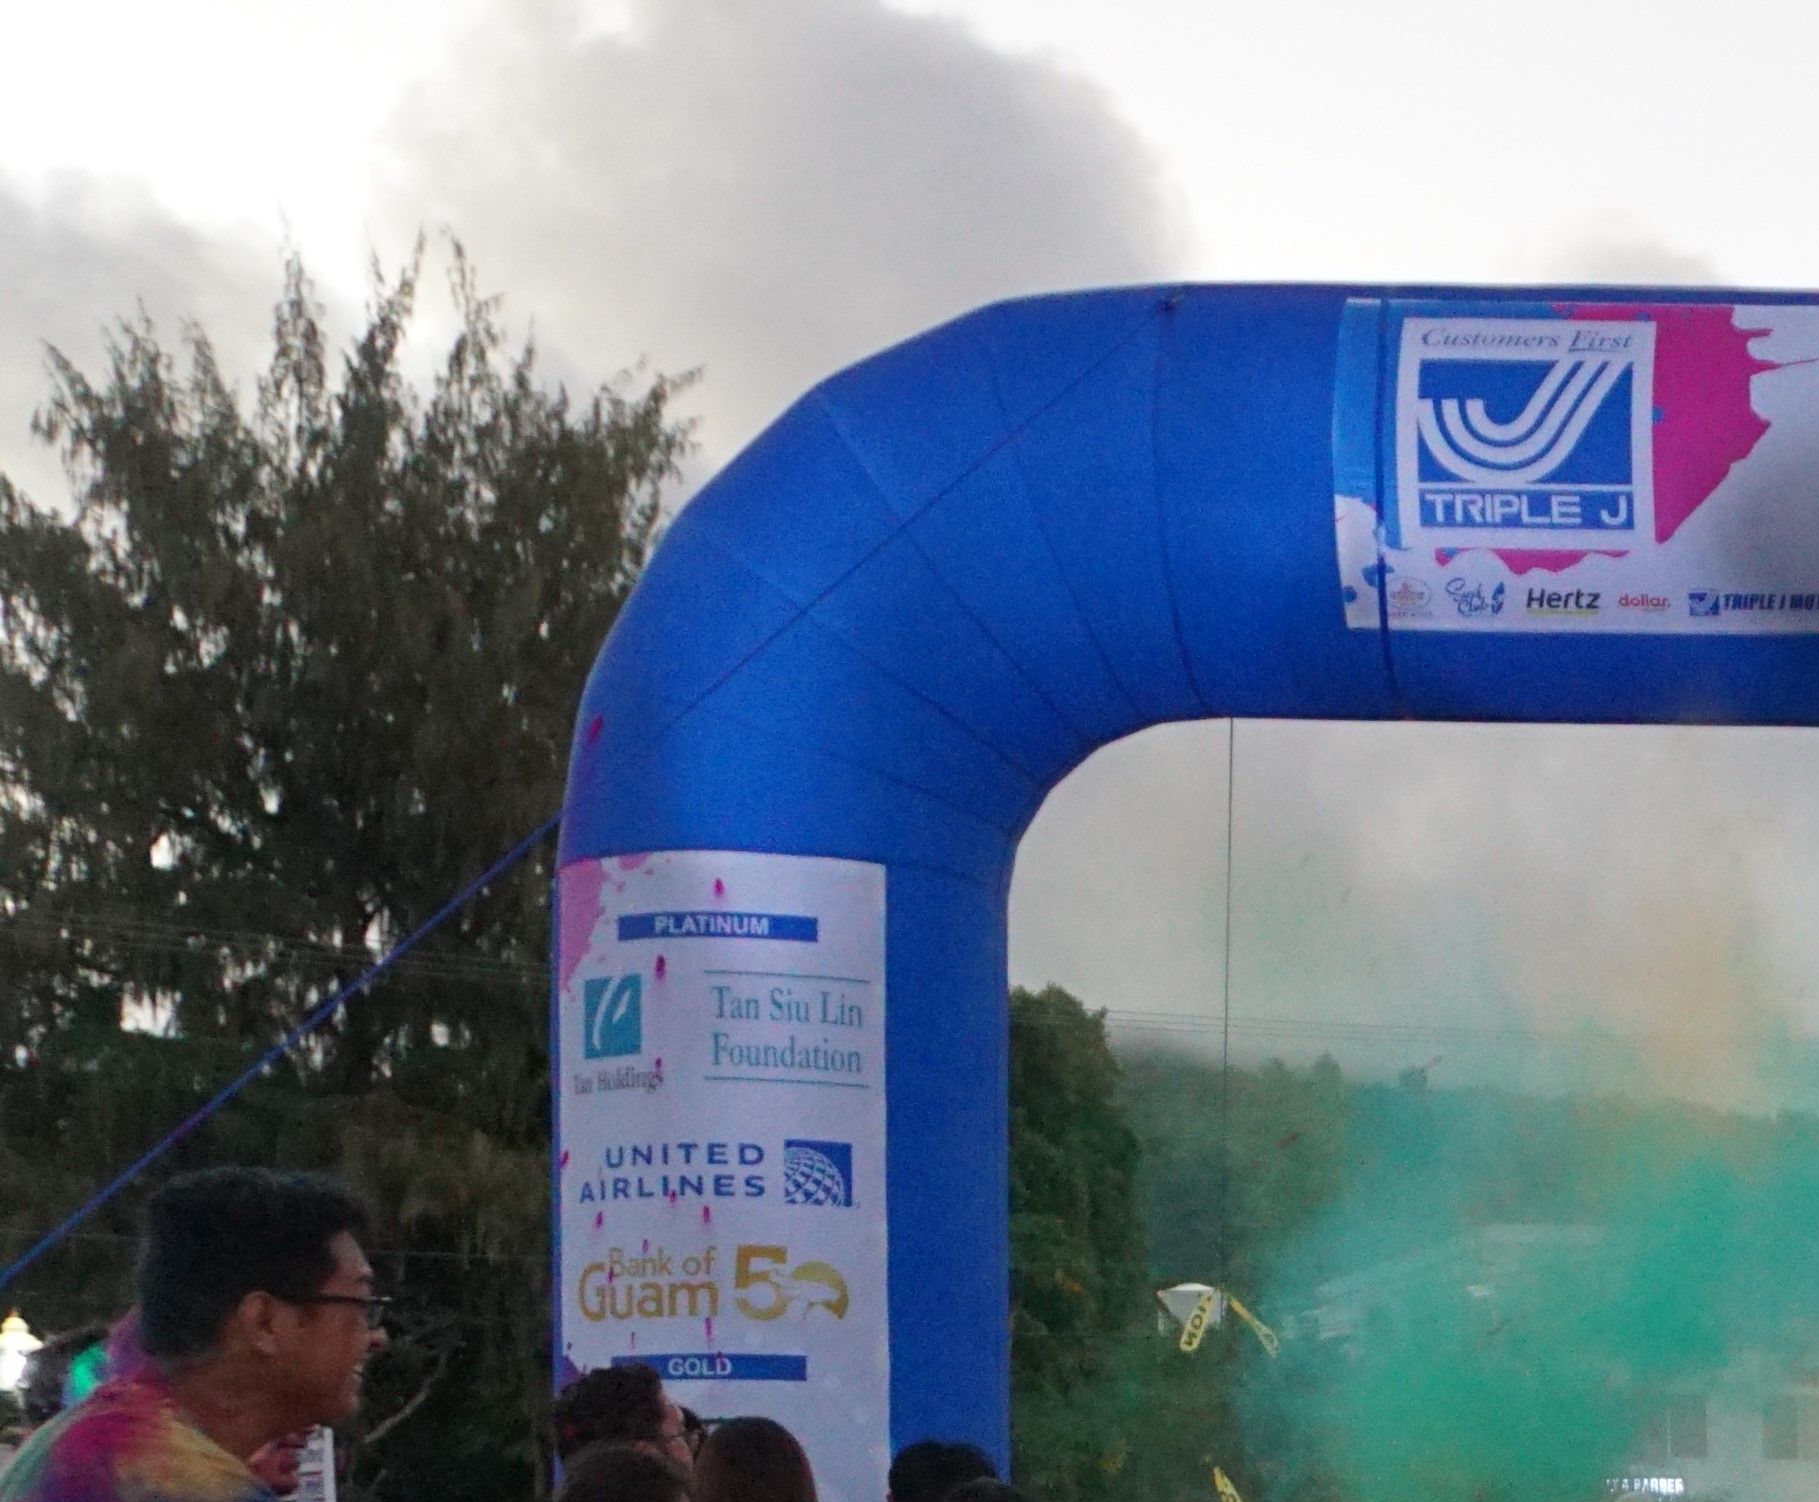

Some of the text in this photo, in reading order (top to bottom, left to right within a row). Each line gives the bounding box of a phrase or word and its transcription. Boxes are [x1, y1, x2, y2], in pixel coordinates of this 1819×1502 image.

[1421, 327, 1635, 349] Customers First
[1424, 493, 1628, 526] TRIPLE J
[1526, 587, 1601, 609] Hertz
[1723, 592, 1775, 611] TRIPLE
[654, 914, 770, 936] PLATINUM
[710, 985, 864, 1028] Tan Siu Lin
[711, 1031, 863, 1074] Foundation
[604, 1142, 767, 1169] UNITED
[579, 1174, 767, 1204] AIRLINES
[609, 1245, 718, 1278] Bank of
[578, 1261, 720, 1322] Guam
[667, 1357, 733, 1377] GOLD
